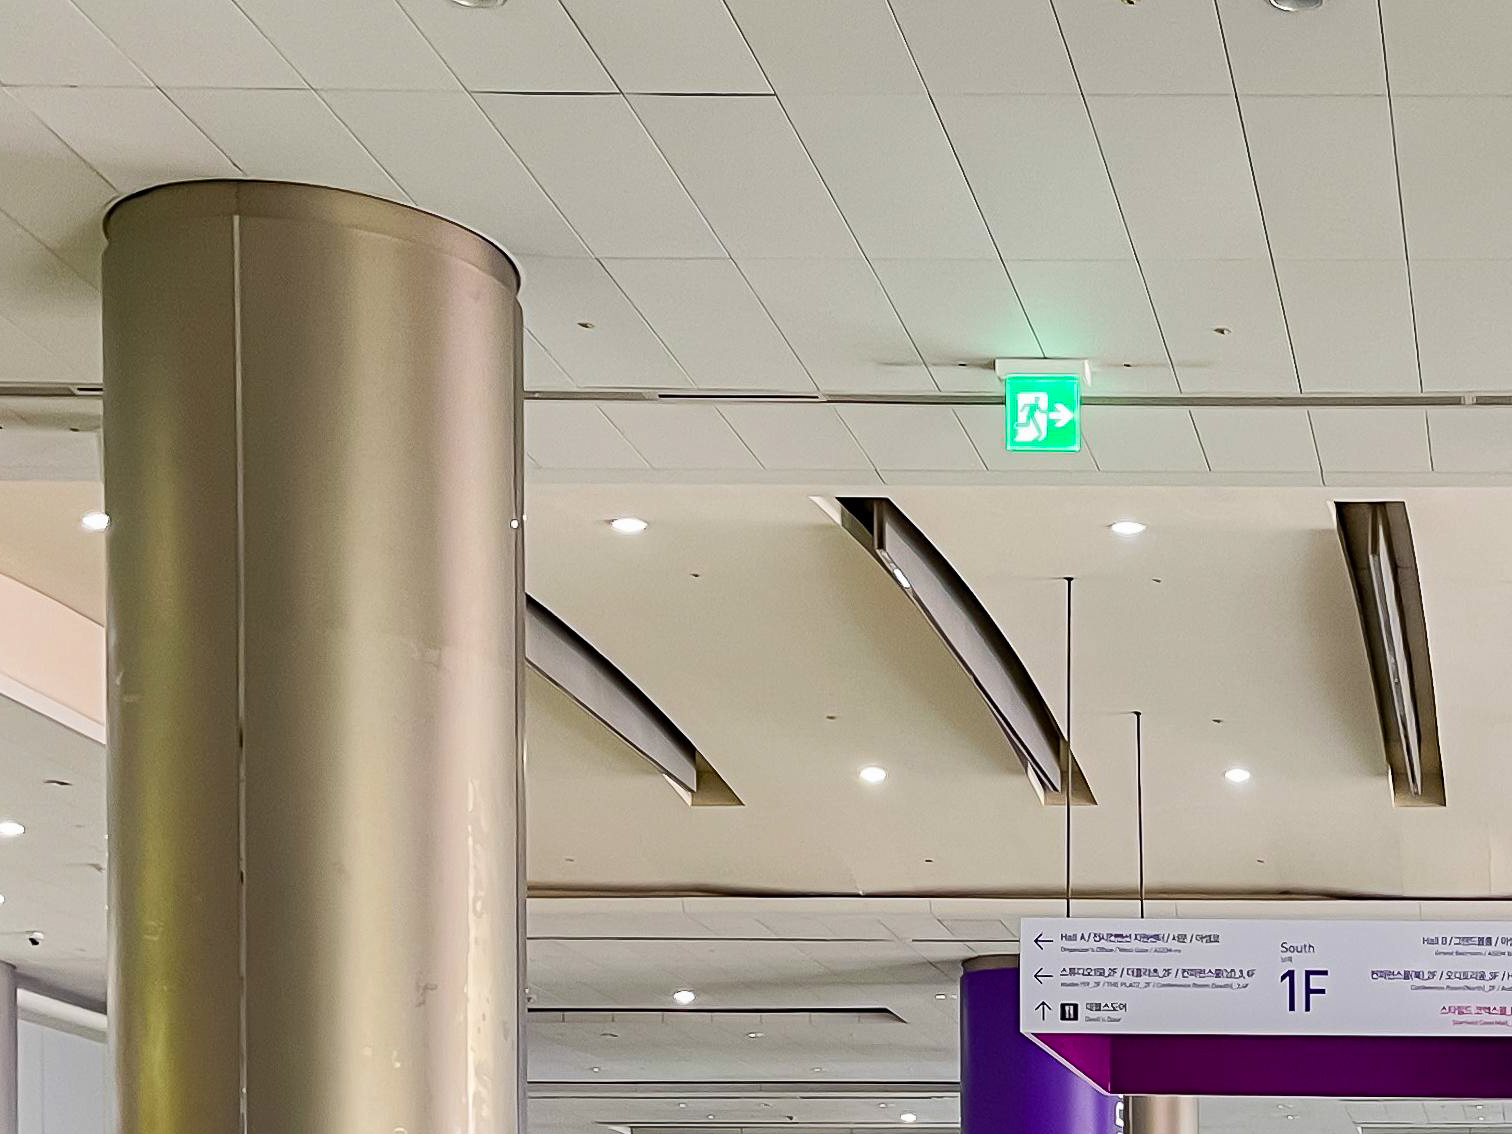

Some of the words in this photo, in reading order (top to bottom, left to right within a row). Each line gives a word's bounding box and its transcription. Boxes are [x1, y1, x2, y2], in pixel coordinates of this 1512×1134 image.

[1060, 933, 1077, 942] Hall
[1422, 937, 1439, 945] Hall
[1280, 942, 1315, 953] South
[1280, 969, 1329, 1012] 1F
